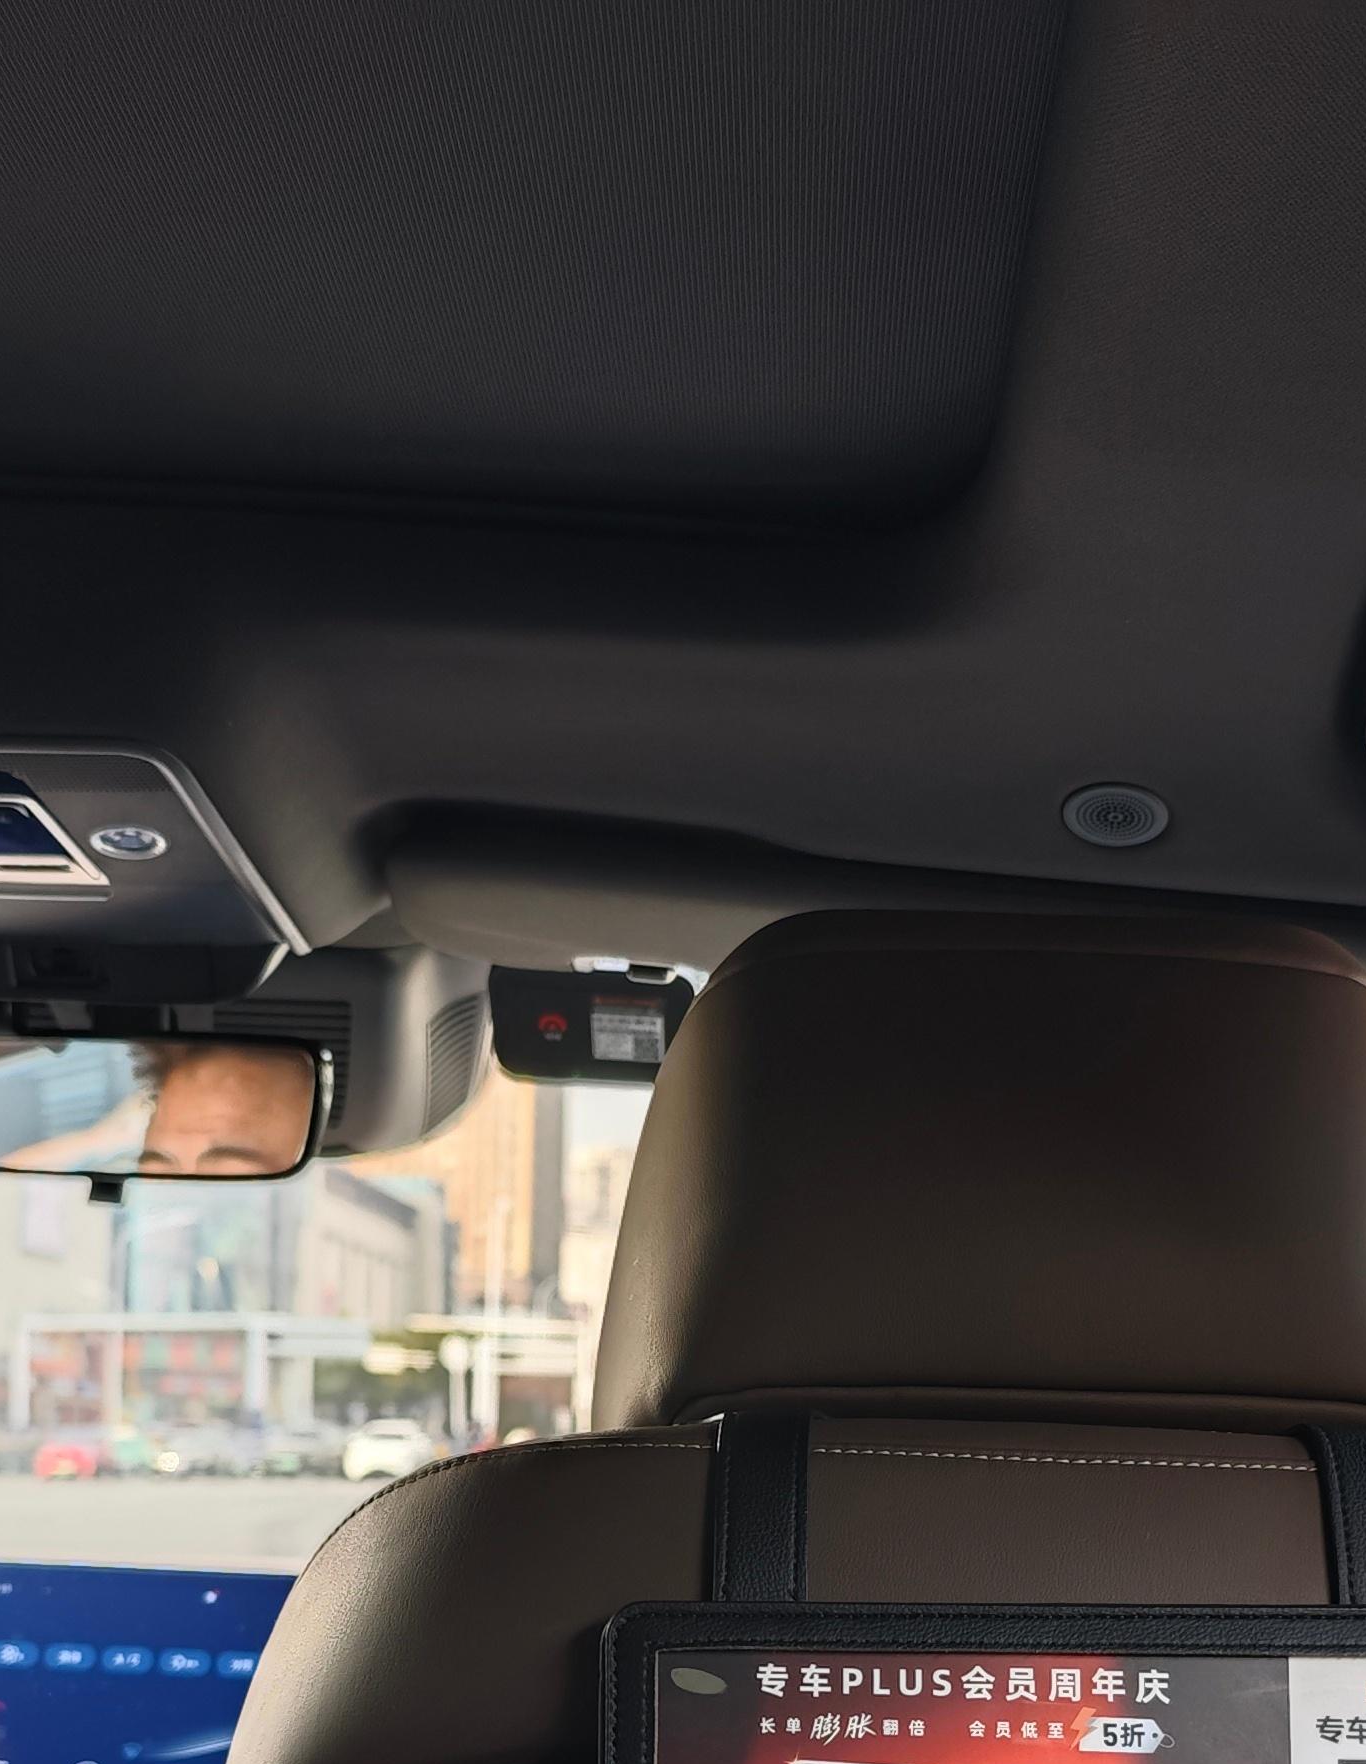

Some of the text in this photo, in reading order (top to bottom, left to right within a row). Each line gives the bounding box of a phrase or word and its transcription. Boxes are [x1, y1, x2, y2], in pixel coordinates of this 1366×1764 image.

[756, 1663, 1171, 1705] 专车PLUS会员周年庆
[759, 1712, 1146, 1748] 长单膨胀翻倍 会员低至 5折
